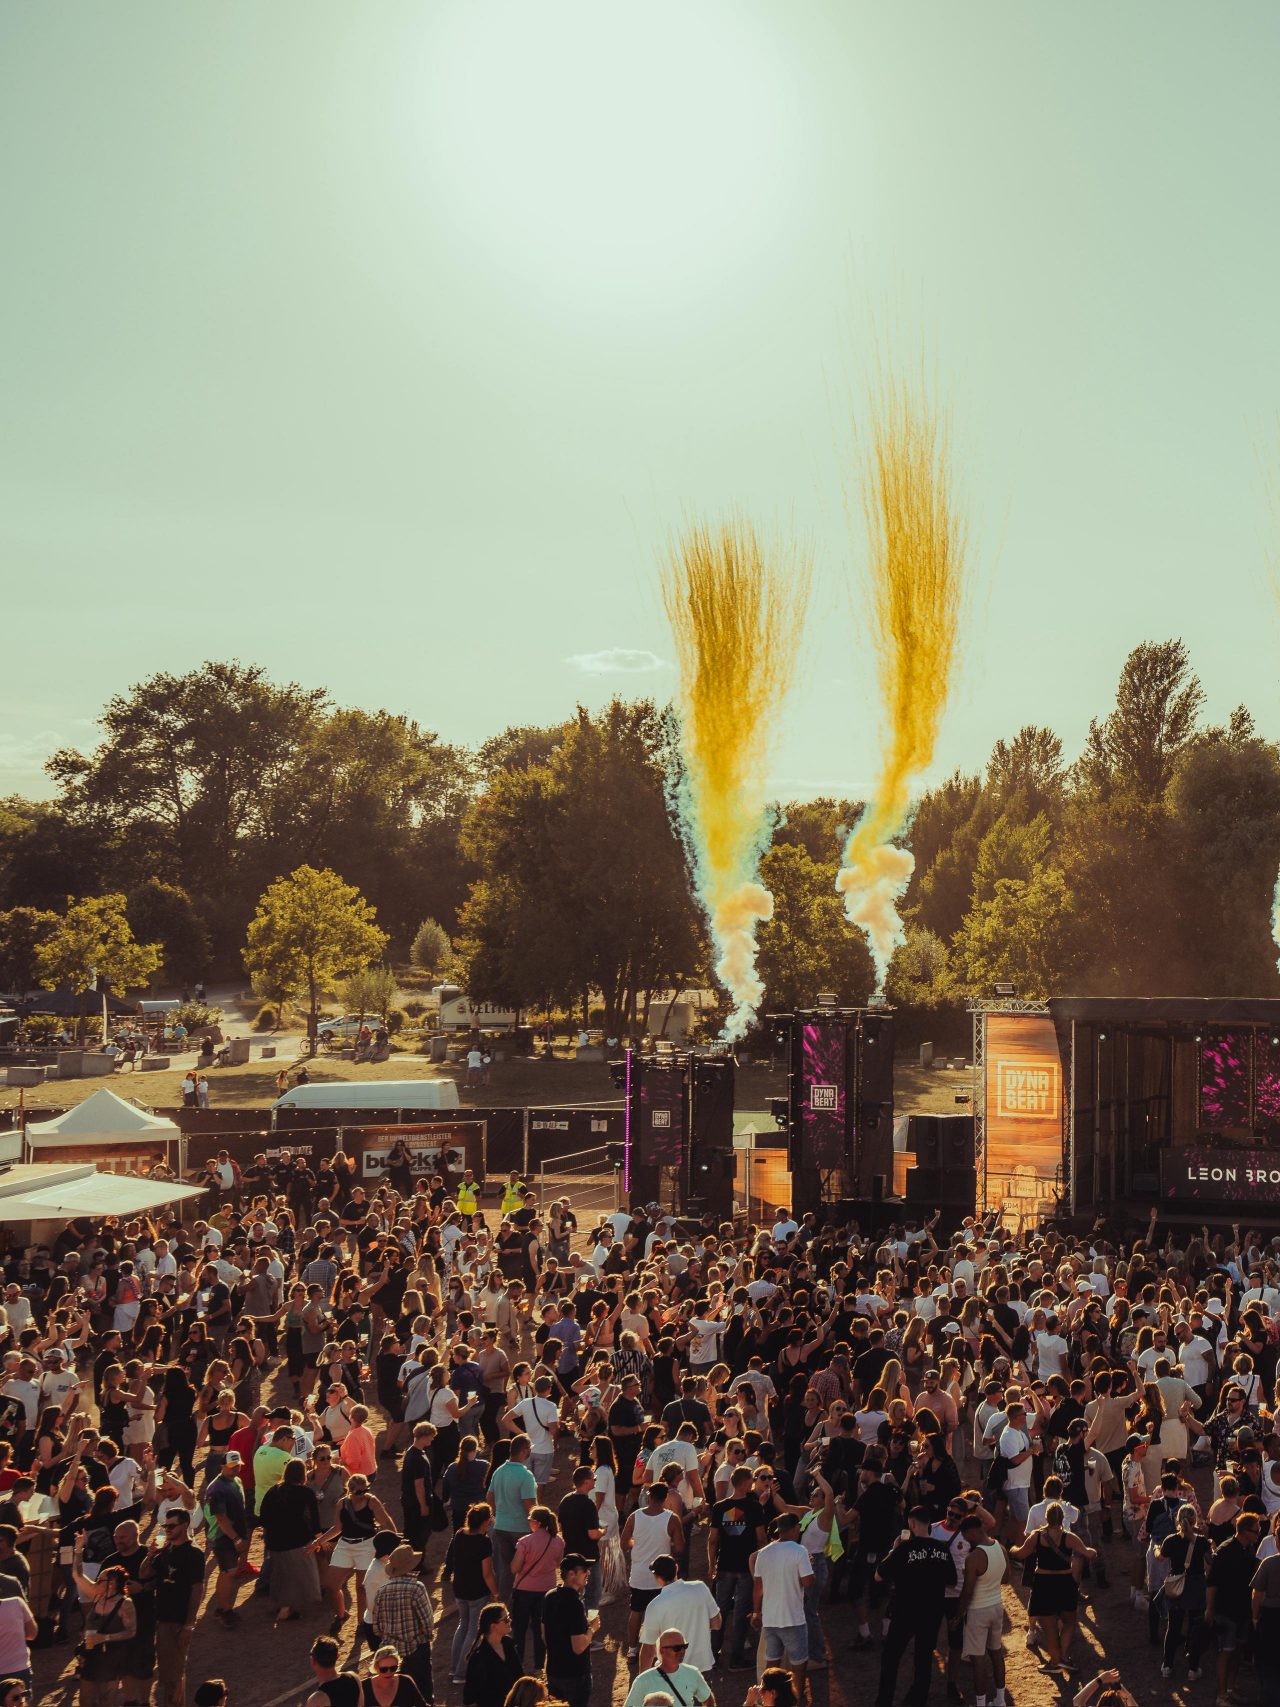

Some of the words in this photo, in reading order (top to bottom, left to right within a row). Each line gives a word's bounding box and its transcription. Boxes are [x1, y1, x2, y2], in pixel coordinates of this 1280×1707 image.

[1005, 1069, 1049, 1090] DYNA
[815, 1089, 834, 1098] DYNA
[1005, 1089, 1049, 1110] BEAT
[815, 1097, 834, 1106] BEAT
[1188, 1167, 1237, 1182] LEON
